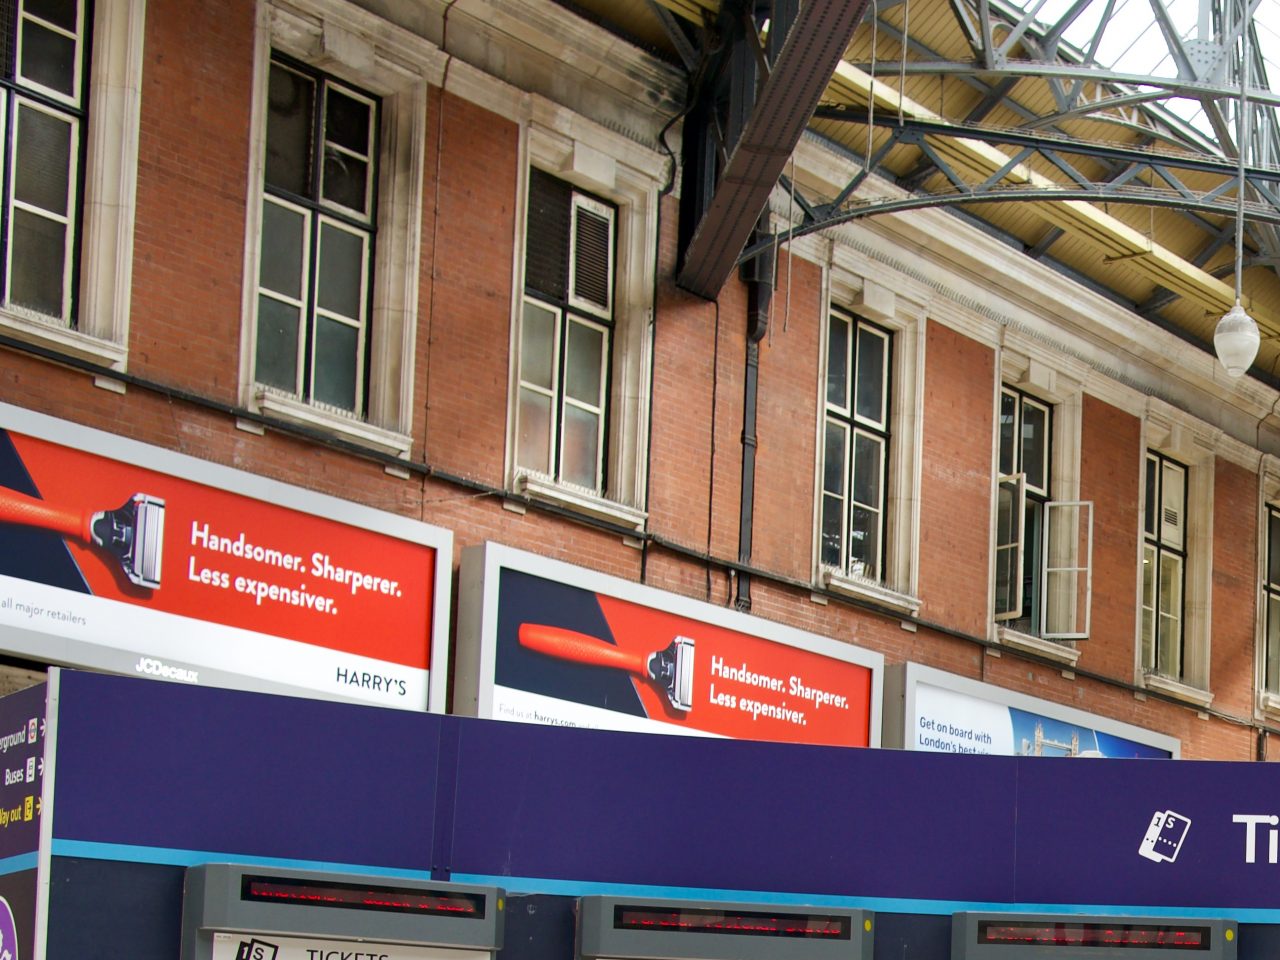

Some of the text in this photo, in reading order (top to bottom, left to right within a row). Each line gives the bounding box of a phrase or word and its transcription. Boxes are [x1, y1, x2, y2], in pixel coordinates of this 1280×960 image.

[191, 520, 402, 598] Handsomer. Sharperer.
[189, 556, 338, 615] Less expensiver.
[1, 597, 86, 626] all major retailers
[136, 657, 198, 683] JCDecaux
[336, 667, 407, 696] HARRY'S
[711, 656, 849, 710] Handsomer. Sharperer.
[709, 684, 808, 725] Less expensiver.
[920, 716, 992, 745] Get on board with
[920, 733, 956, 753] London's
[5, 769, 24, 786] Buses
[10, 805, 22, 822] out
